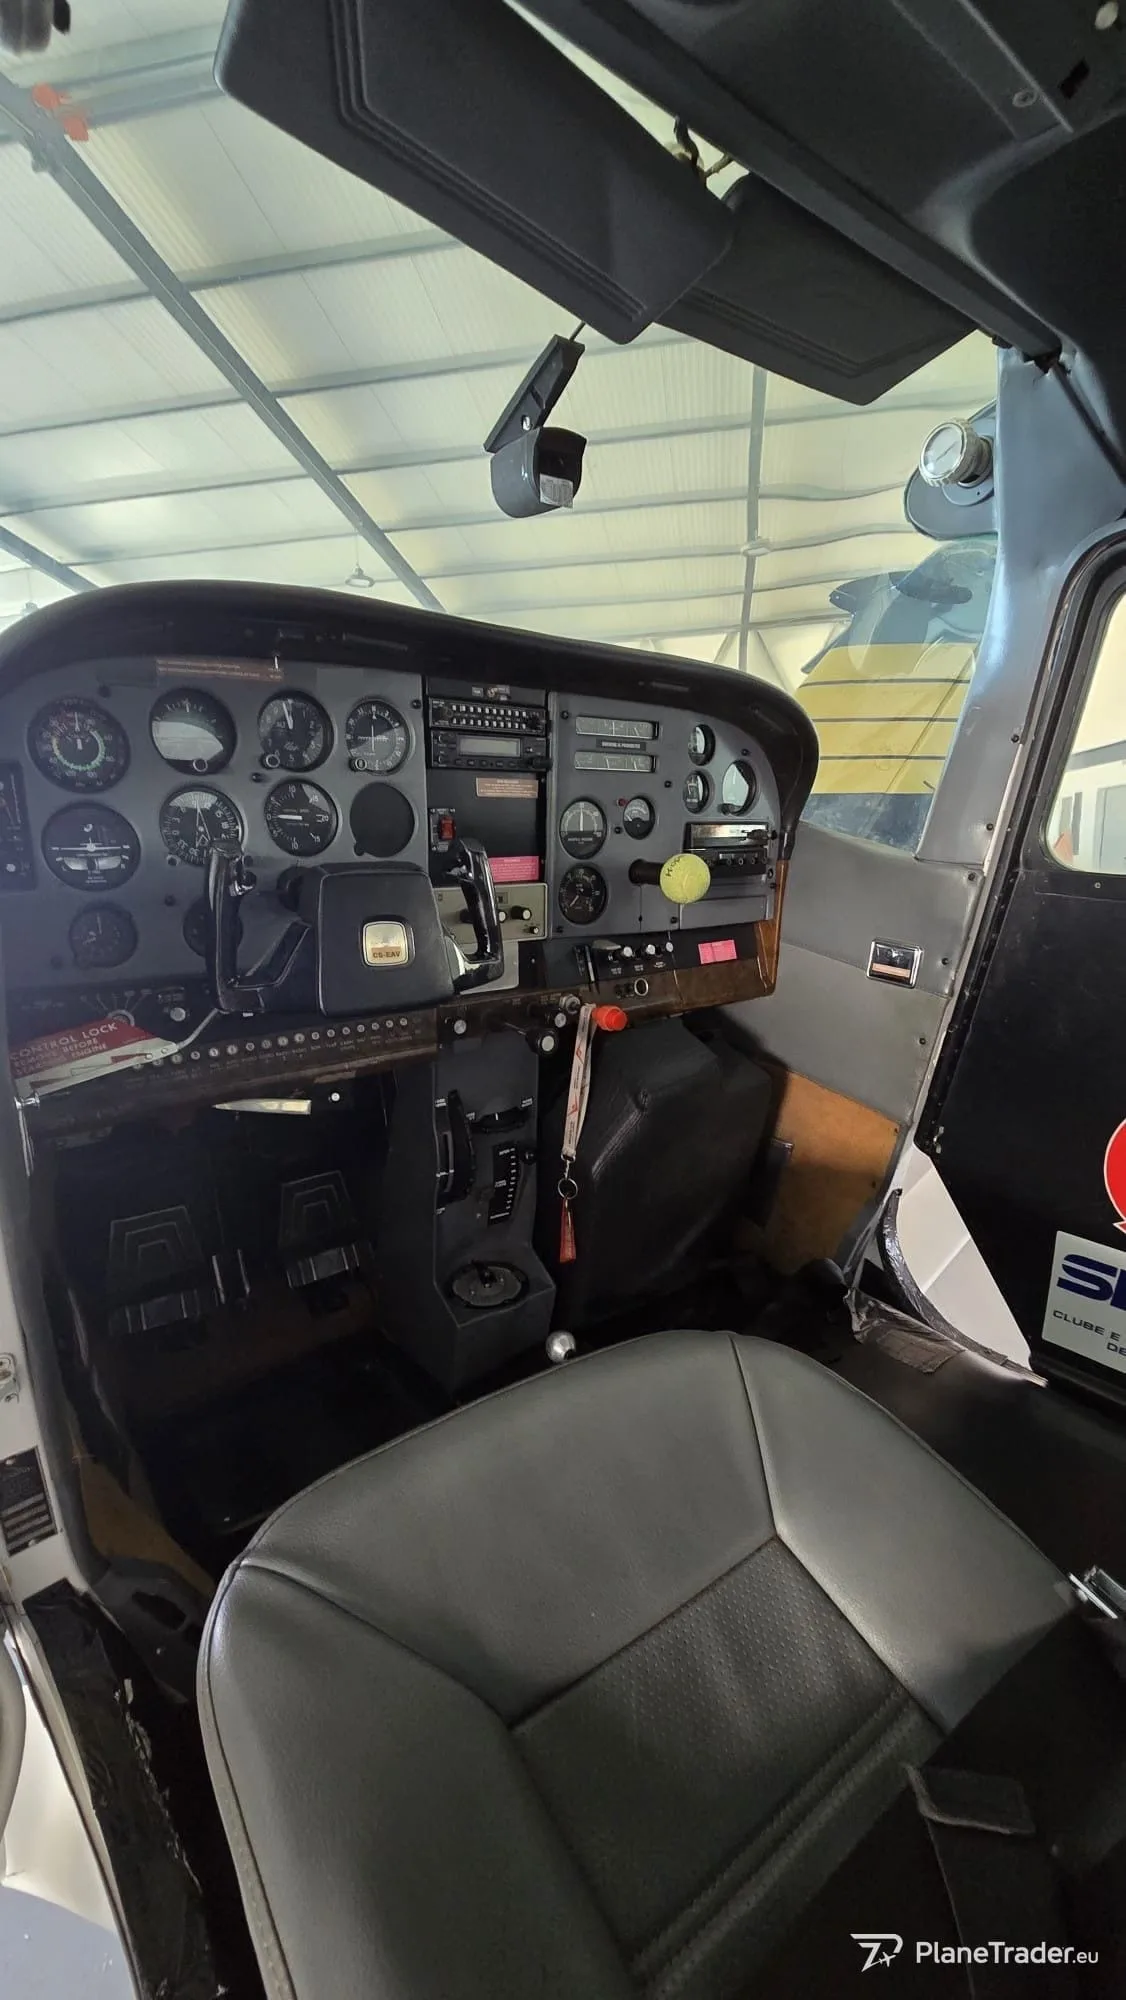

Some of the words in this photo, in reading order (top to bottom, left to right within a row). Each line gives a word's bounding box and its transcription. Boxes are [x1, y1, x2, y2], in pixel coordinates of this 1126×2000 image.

[372, 951, 401, 959] CS-EAV
[10, 1035, 78, 1061] CONTROL
[82, 1022, 118, 1039] LOCK
[62, 1039, 99, 1053] BEFORE
[71, 1043, 107, 1059] ENGINE
[1053, 1310, 1105, 1336] CLUBE
[1110, 1331, 1121, 1342] E
